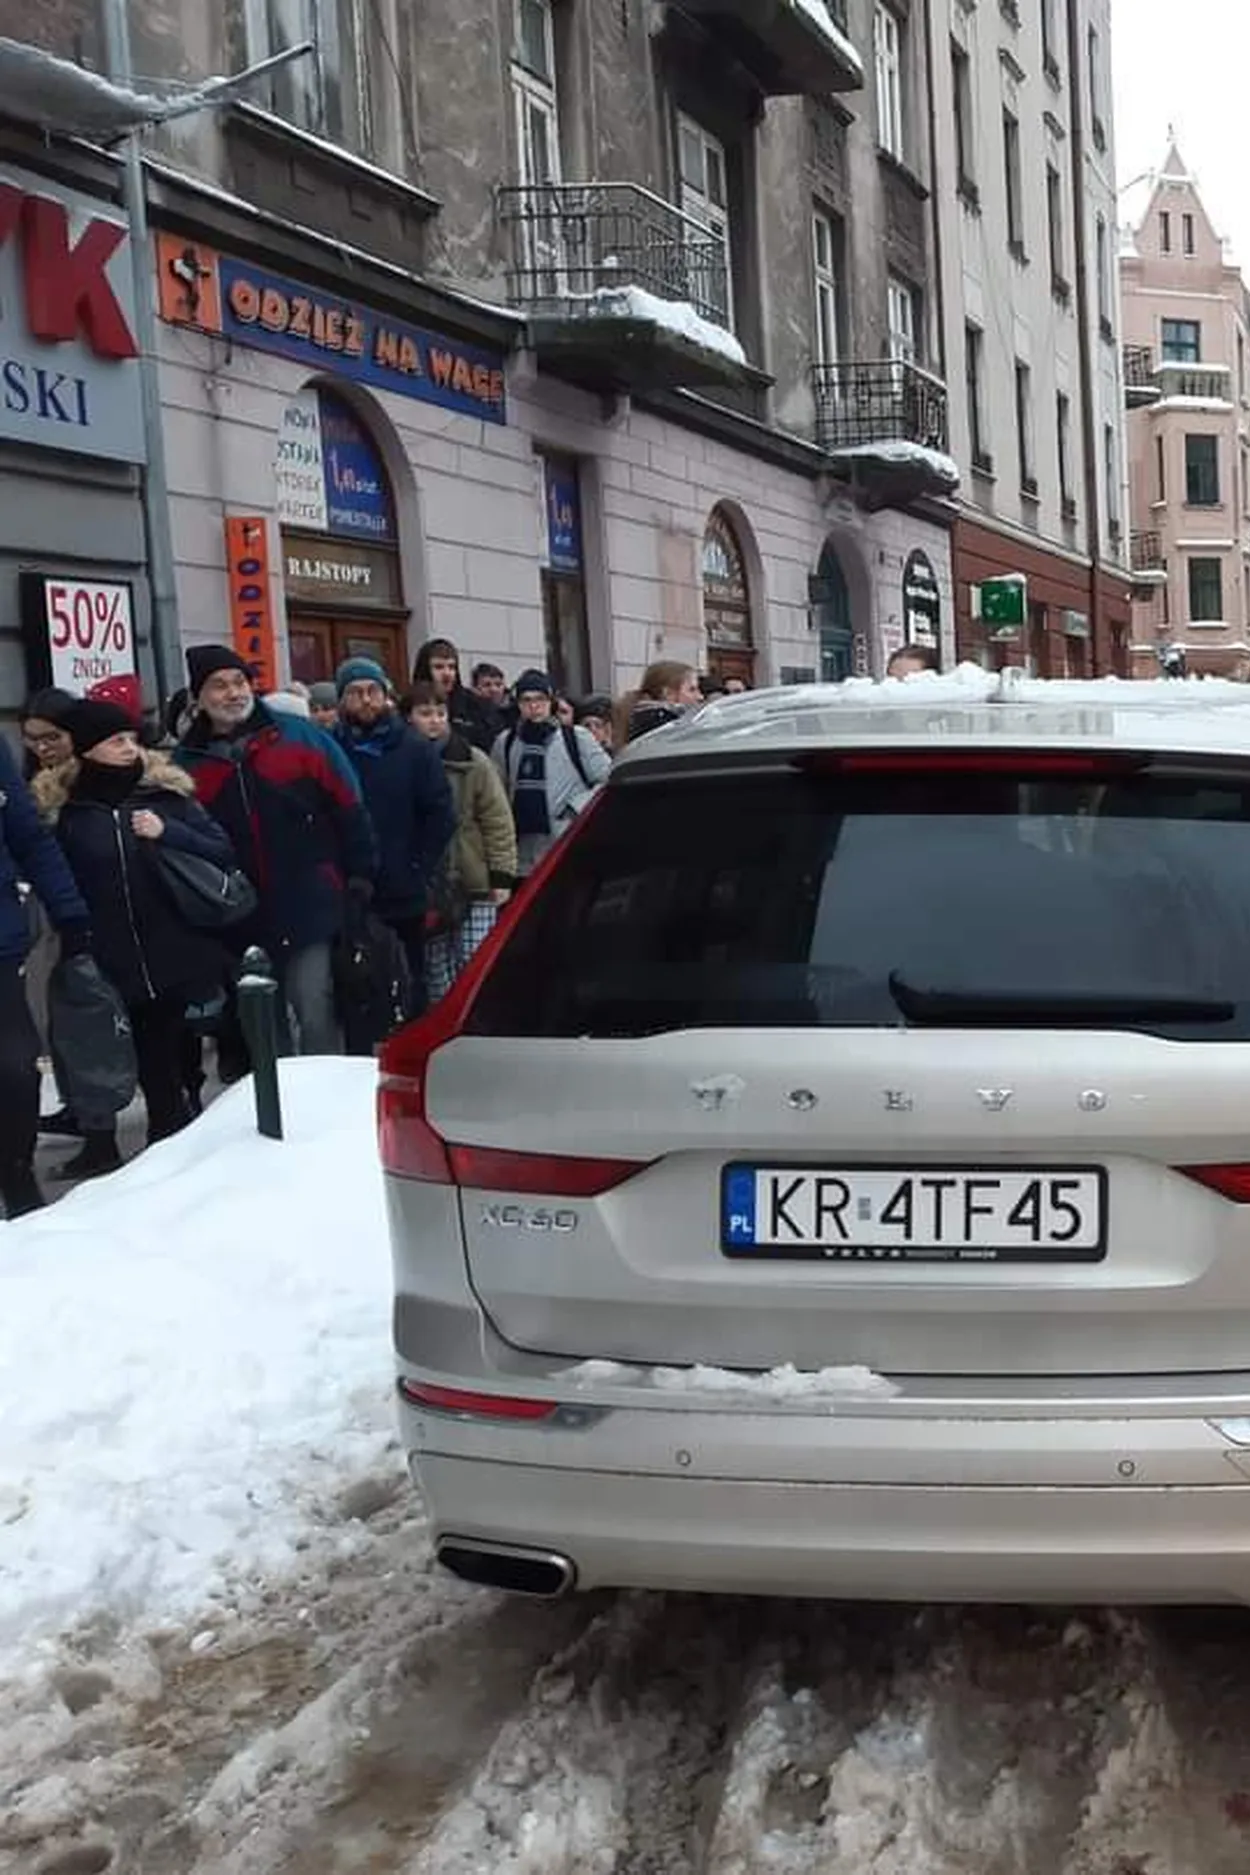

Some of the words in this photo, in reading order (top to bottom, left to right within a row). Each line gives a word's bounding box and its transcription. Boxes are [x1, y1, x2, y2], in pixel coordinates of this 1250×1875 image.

[0, 184, 140, 359] K
[374, 326, 424, 377] NA
[2, 360, 90, 427] SKI
[288, 555, 371, 586] RAJSTOPY
[51, 586, 126, 652] 50%
[730, 1214, 754, 1232] PL
[771, 1177, 852, 1240] KR
[879, 1178, 1083, 1242] 4TF45
